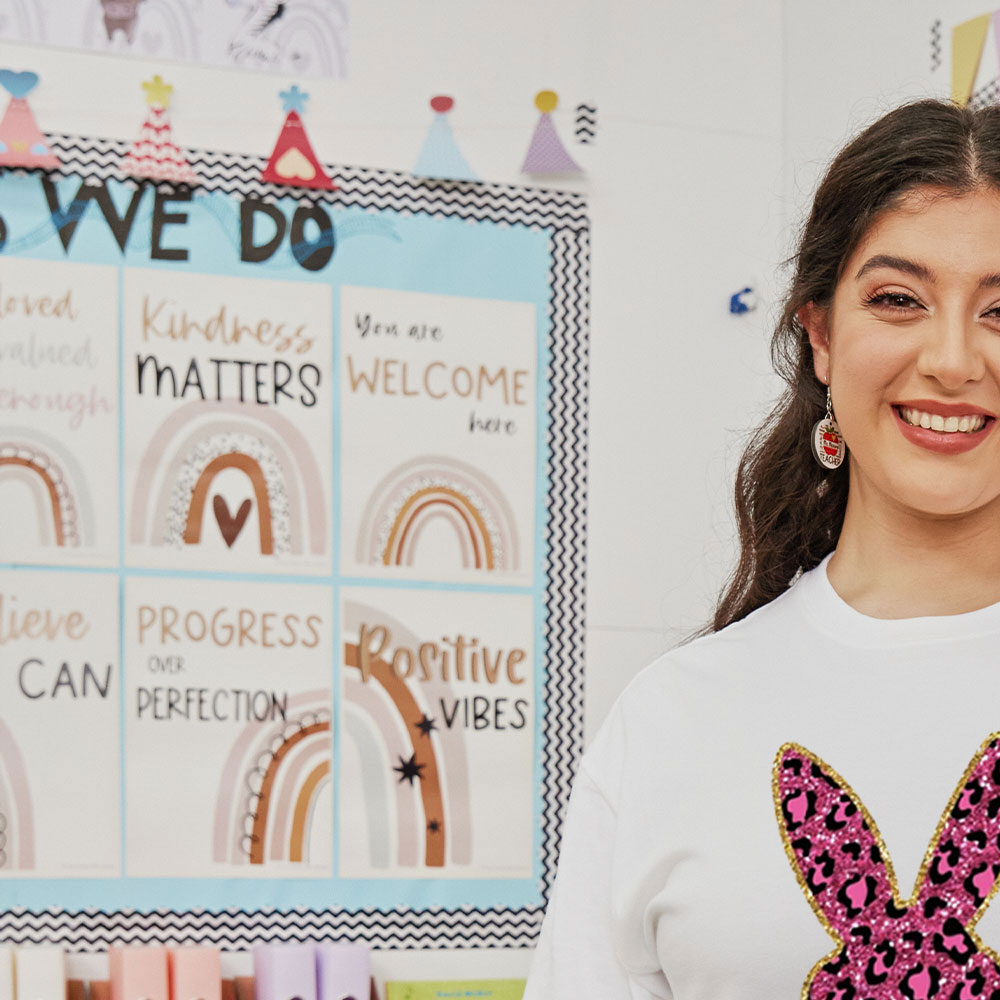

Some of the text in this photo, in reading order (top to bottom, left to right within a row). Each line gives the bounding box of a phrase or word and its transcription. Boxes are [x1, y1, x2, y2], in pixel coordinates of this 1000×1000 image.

[41, 175, 190, 262] WE
[239, 198, 336, 272] DO
[140, 295, 316, 355] Kindness
[355, 312, 445, 342] You are
[136, 354, 321, 408] MATTERS
[347, 354, 529, 406] WELCOME
[467, 410, 518, 436] here
[138, 604, 324, 648] PROGRESS
[149, 655, 186, 676] OVER
[357, 622, 527, 685] Positive
[18, 657, 112, 699] CAN
[136, 686, 288, 722] PERFECTION
[440, 696, 529, 731] VIBES
